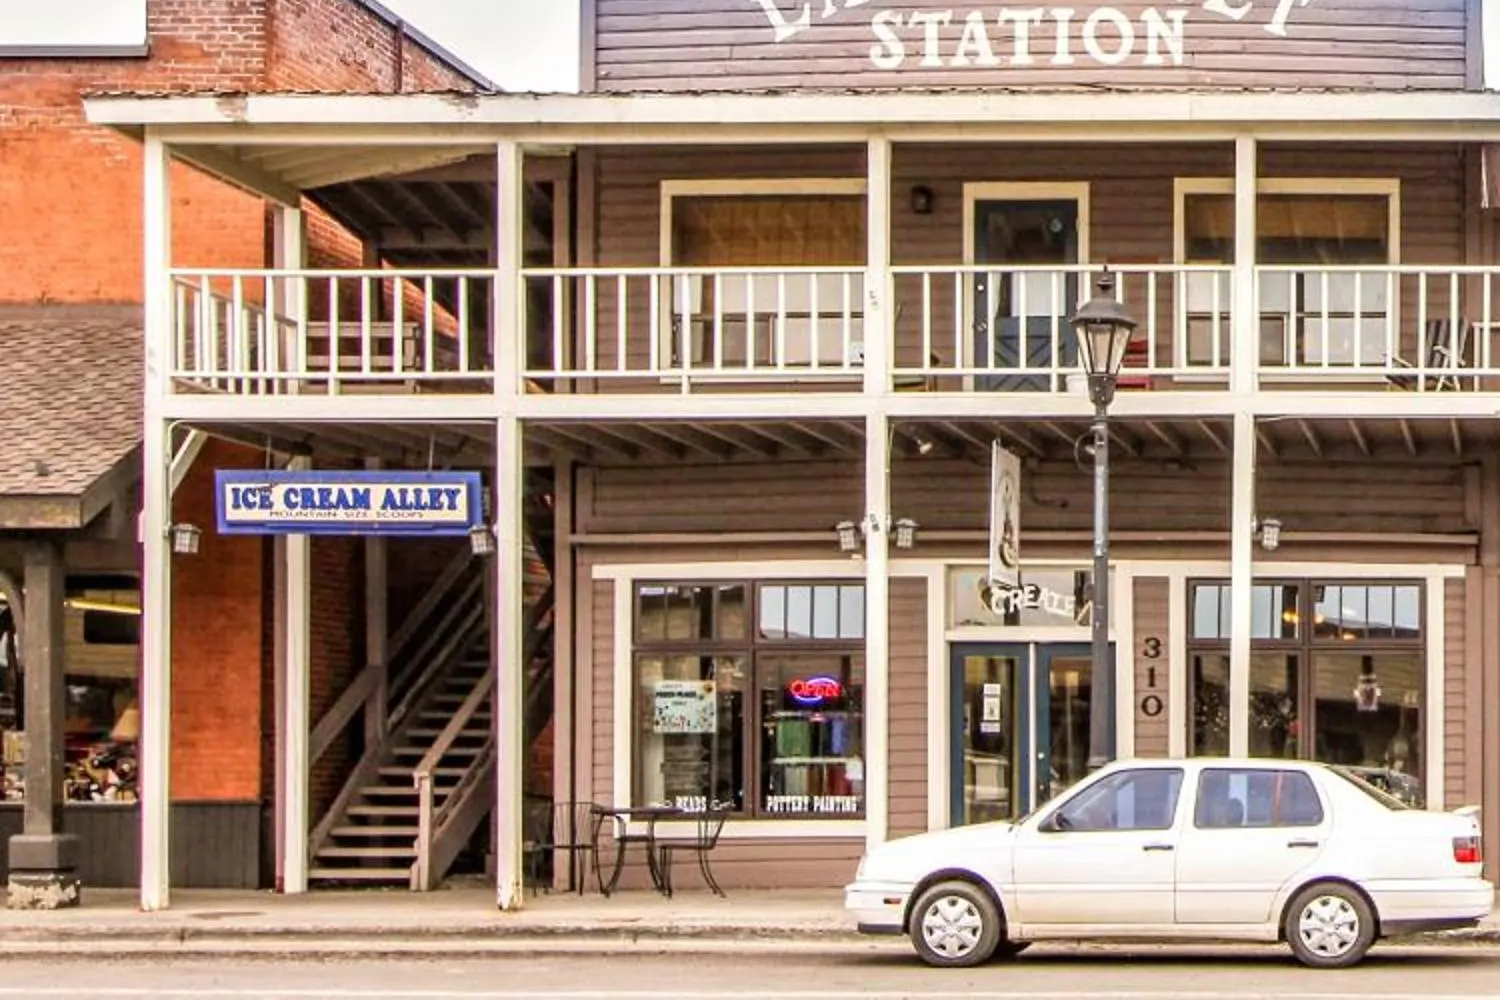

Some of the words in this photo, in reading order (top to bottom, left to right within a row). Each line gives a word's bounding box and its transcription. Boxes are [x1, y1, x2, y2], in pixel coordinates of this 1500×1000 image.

[869, 8, 1188, 68] STATION
[231, 487, 275, 510] ICE
[284, 487, 372, 510] CREAM
[380, 487, 461, 511] ALLEY
[269, 511, 338, 519] MOUNTAIN
[1141, 637, 1163, 716] 310
[790, 680, 842, 697] OPEN
[767, 795, 809, 812] POTTERY
[813, 795, 857, 812] PAINTING
